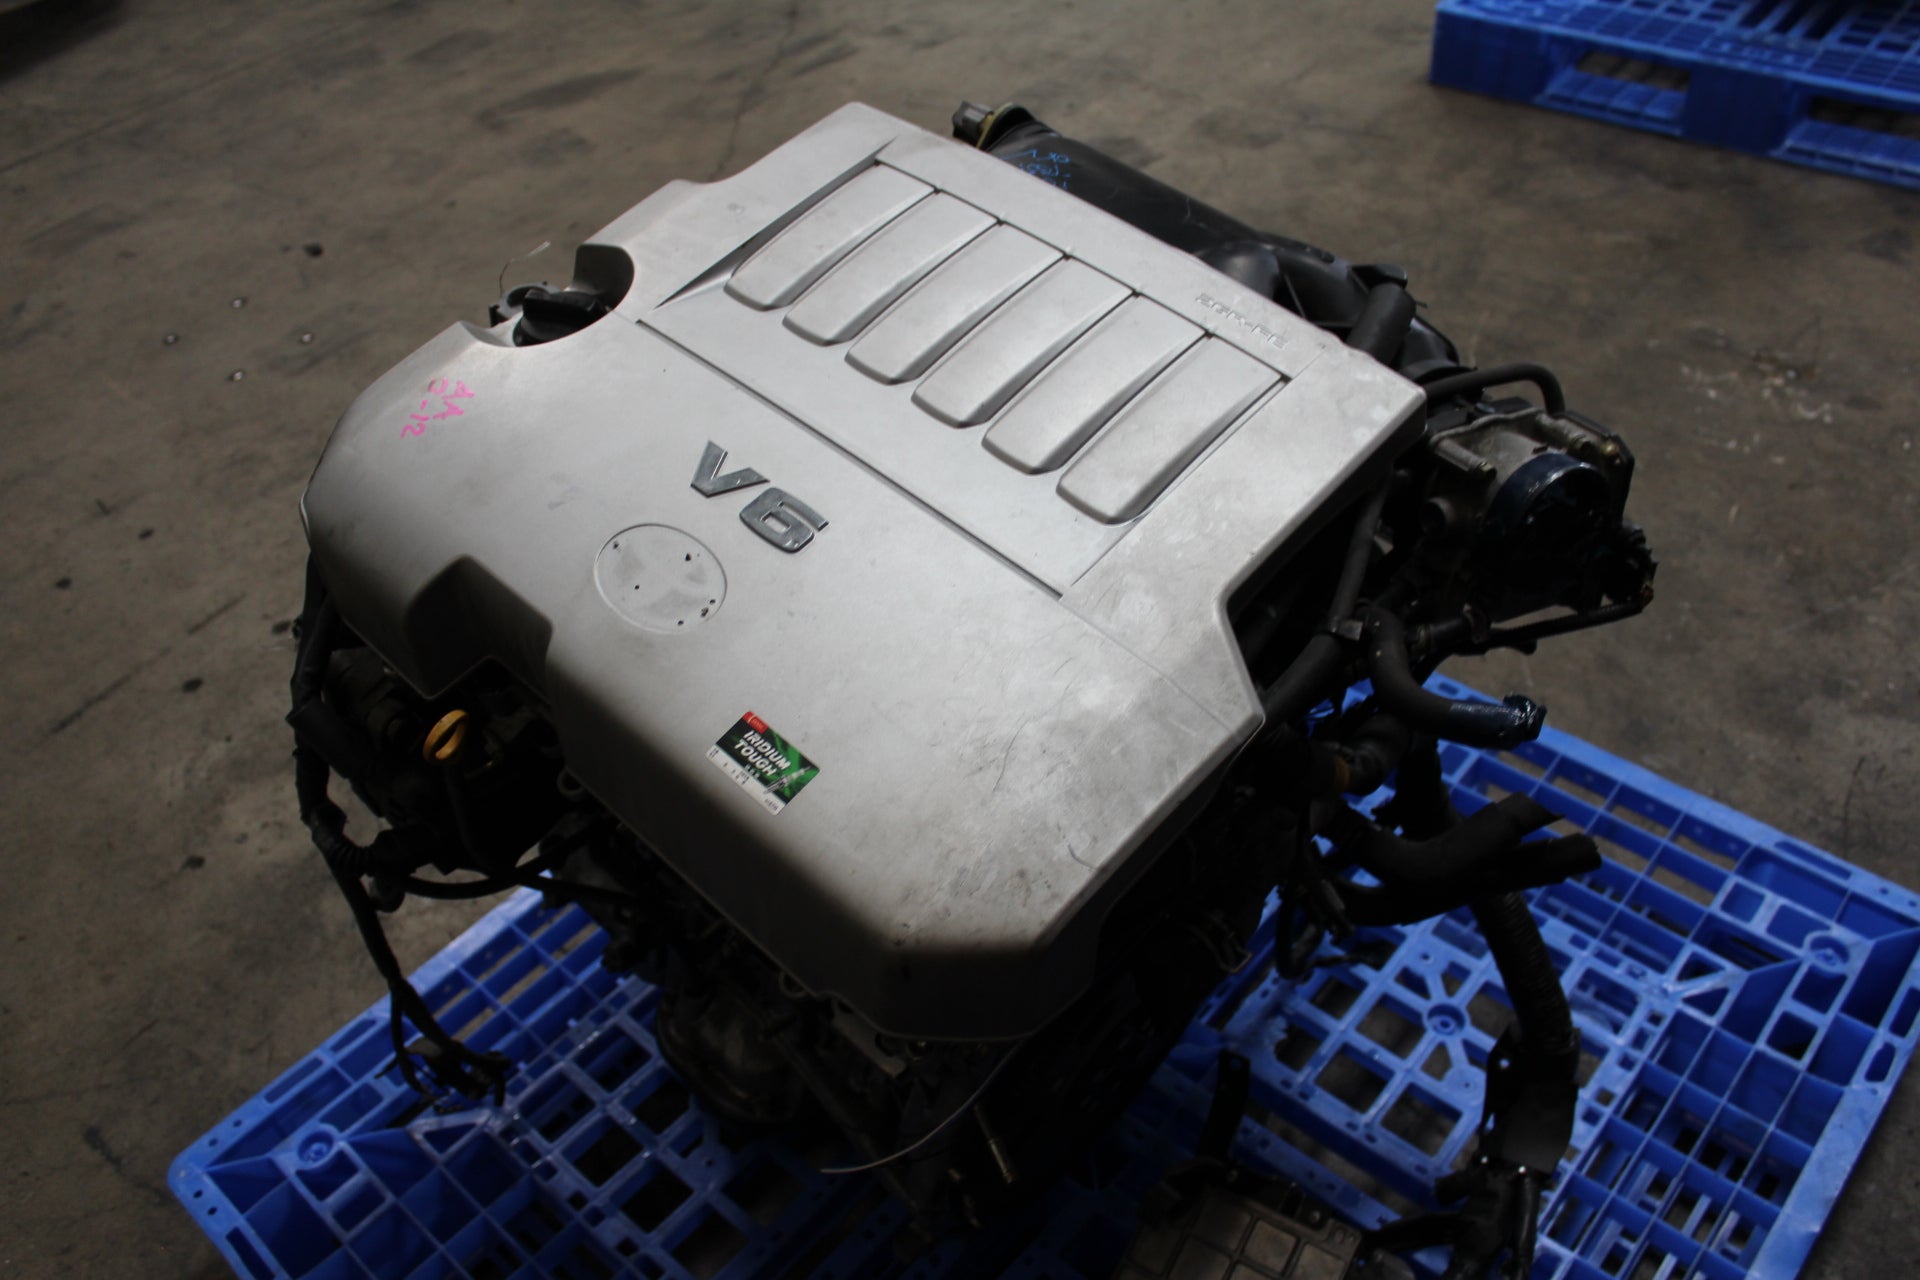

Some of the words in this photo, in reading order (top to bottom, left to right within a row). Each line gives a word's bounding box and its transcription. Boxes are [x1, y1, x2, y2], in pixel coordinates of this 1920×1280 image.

[690, 439, 830, 554] V6
[733, 739, 778, 777] TOUGH
[743, 730, 792, 771] IRIDIUM
